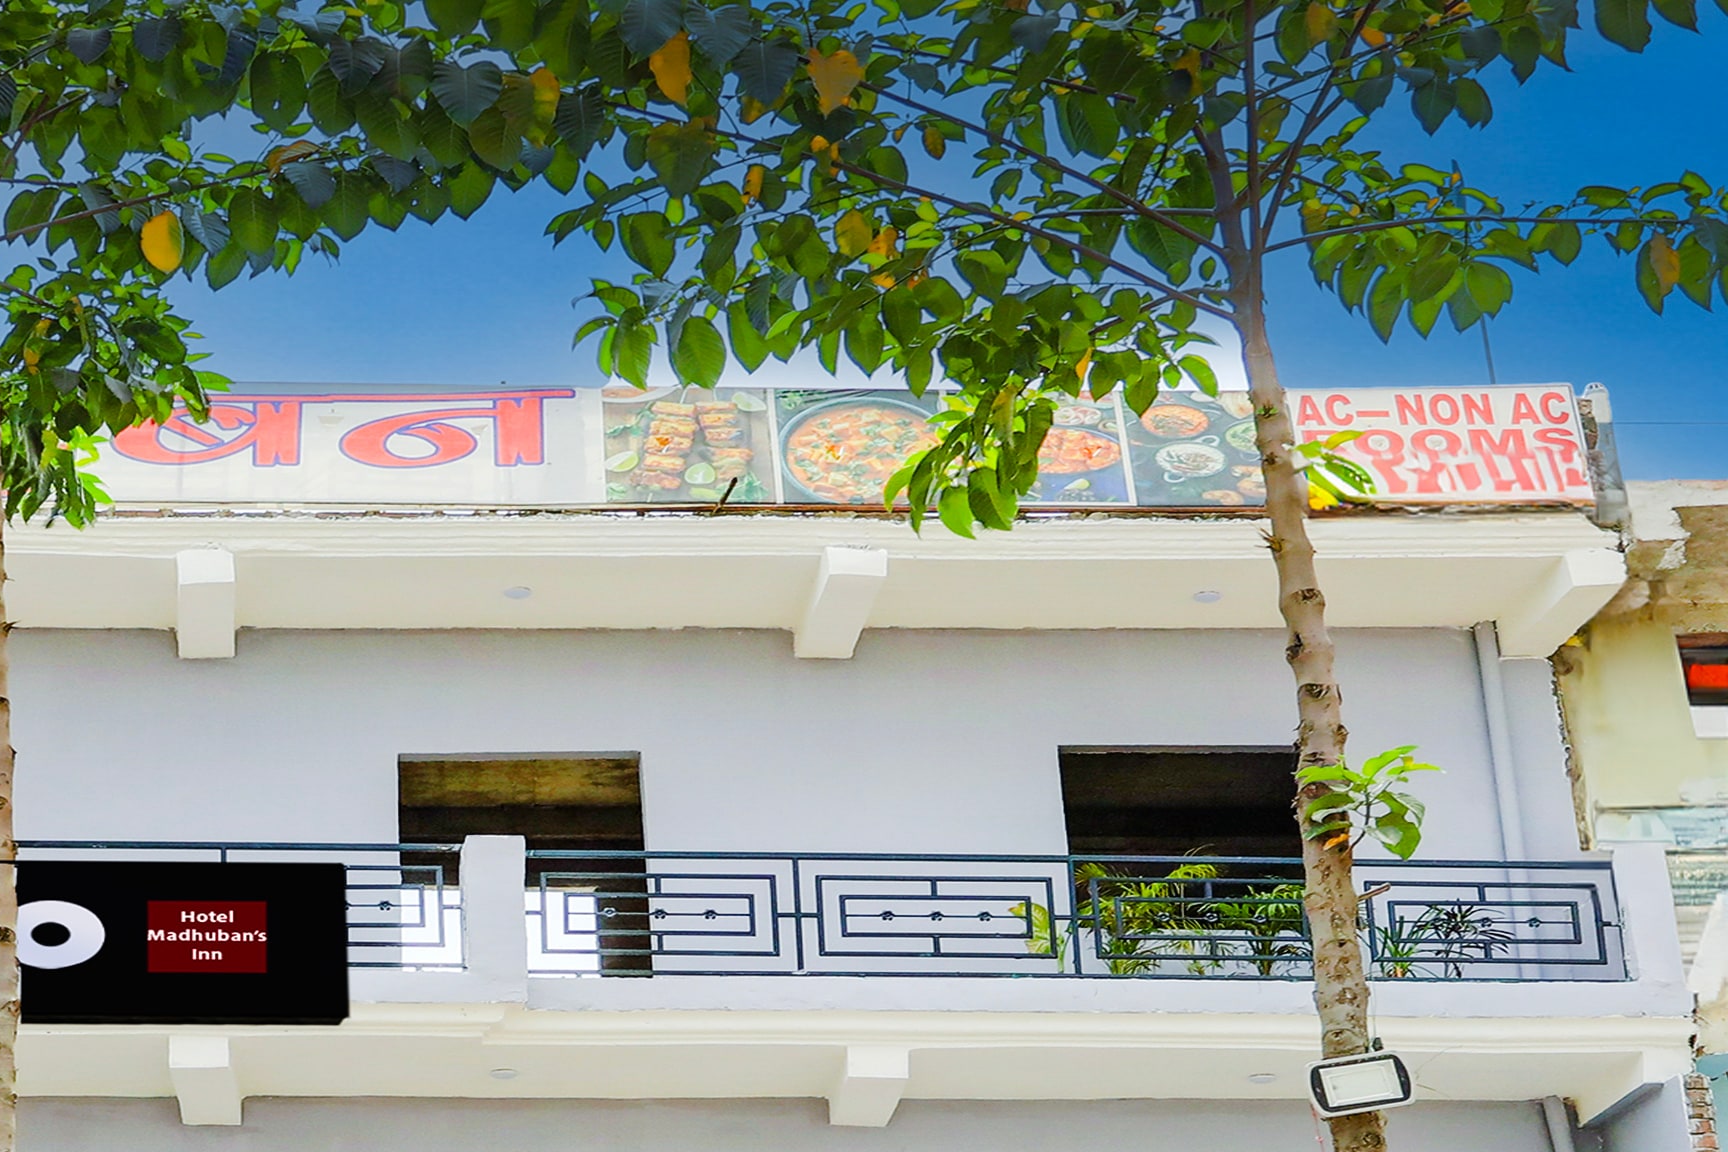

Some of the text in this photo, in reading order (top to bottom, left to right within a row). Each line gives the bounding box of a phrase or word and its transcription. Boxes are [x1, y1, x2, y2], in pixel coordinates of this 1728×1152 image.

[1511, 391, 1570, 425] AC
[180, 910, 234, 923] Hotel
[147, 928, 268, 942] Madhuban's
[192, 948, 223, 961] Inn
